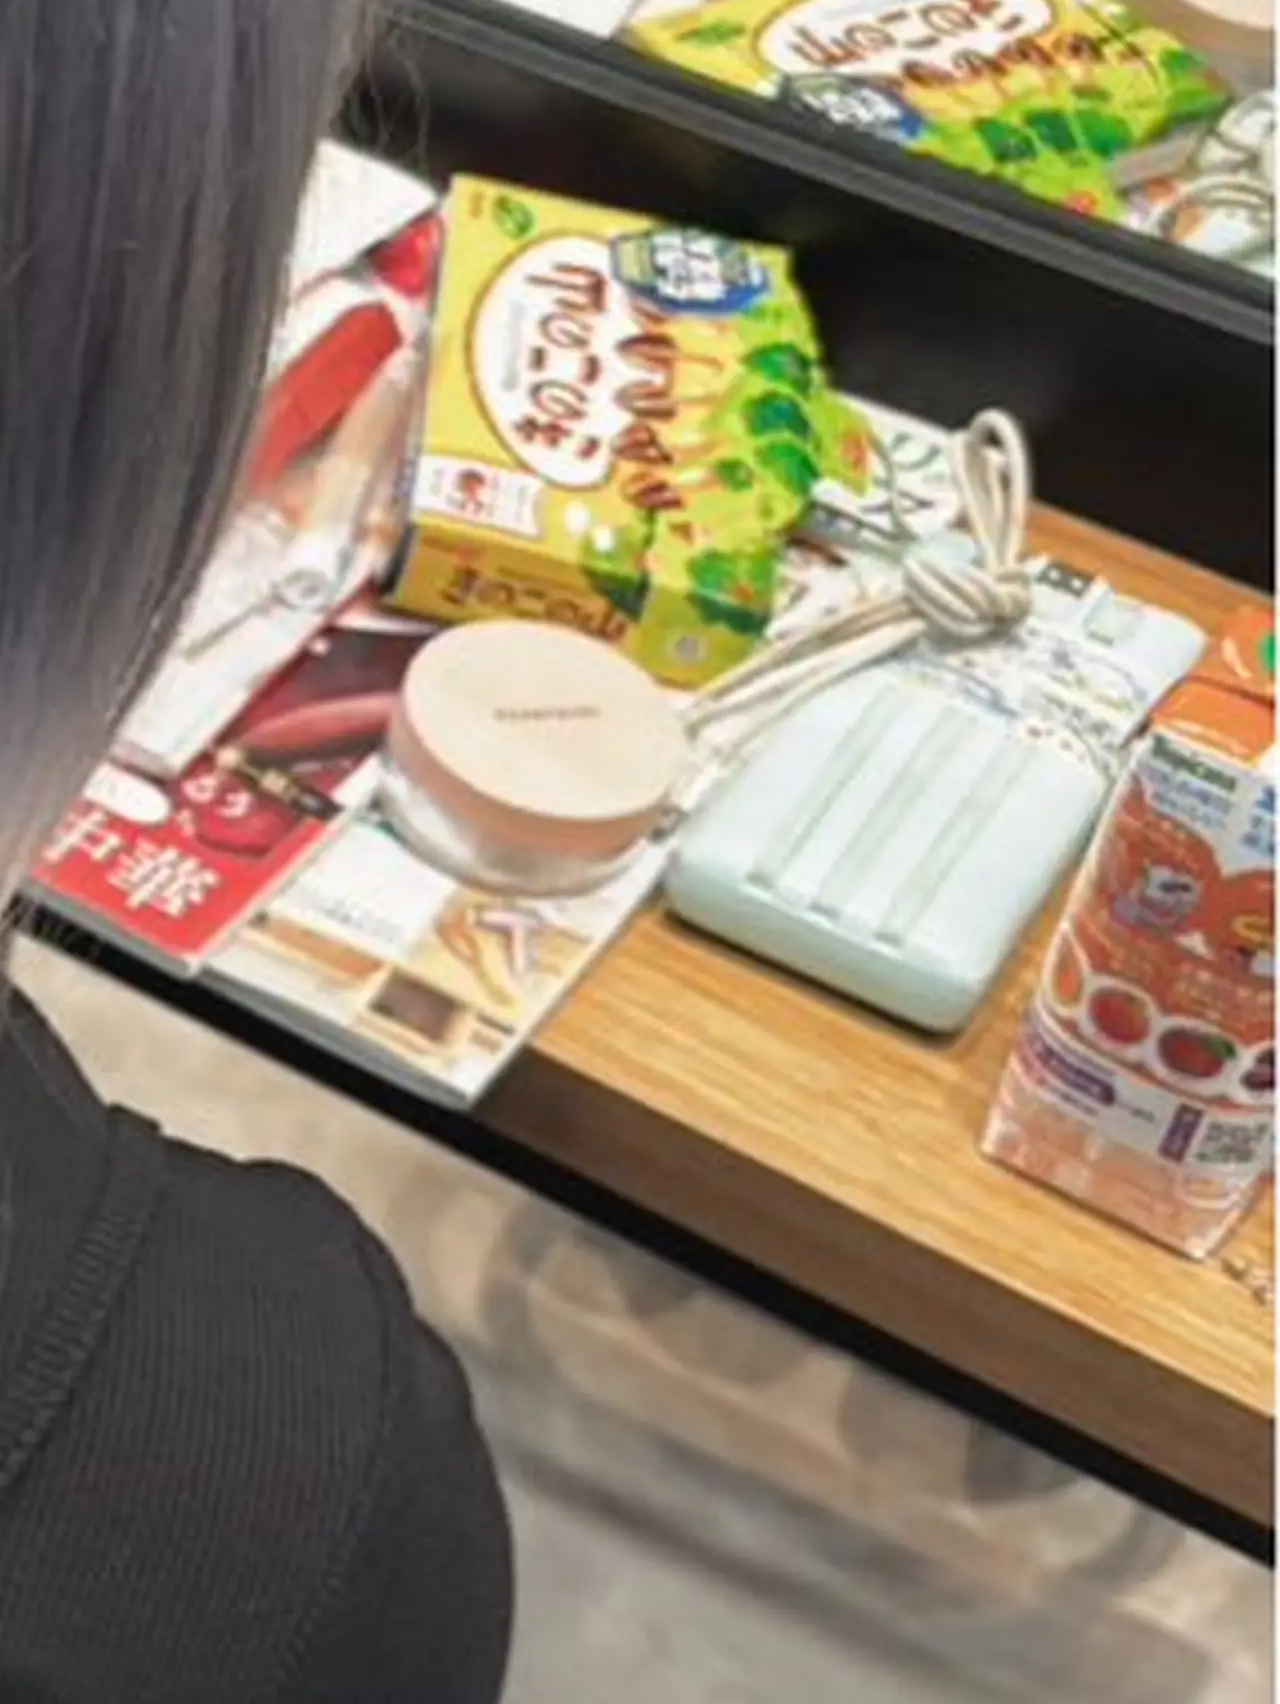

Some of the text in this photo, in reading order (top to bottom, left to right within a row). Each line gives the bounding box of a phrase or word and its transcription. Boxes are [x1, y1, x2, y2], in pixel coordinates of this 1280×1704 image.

[511, 259, 610, 463] きのこの山
